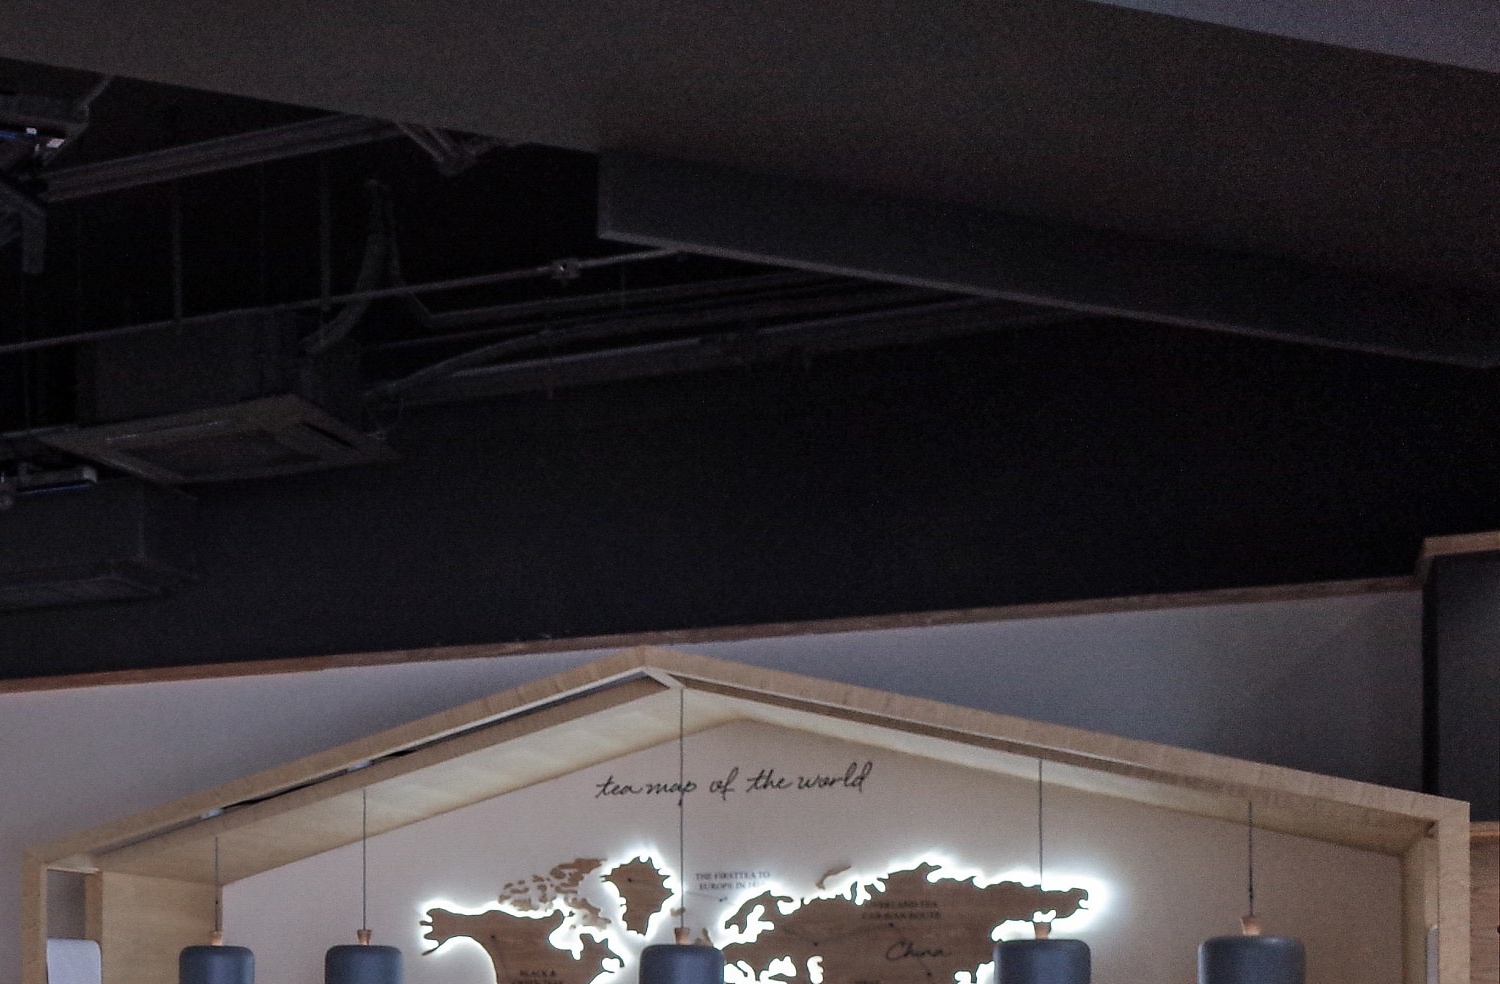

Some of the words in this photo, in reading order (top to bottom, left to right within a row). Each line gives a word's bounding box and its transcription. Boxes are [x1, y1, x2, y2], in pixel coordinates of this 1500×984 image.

[595, 775, 642, 798] tea
[645, 780, 698, 807] map
[709, 766, 739, 801] of
[746, 768, 794, 793] the
[797, 761, 873, 793] world
